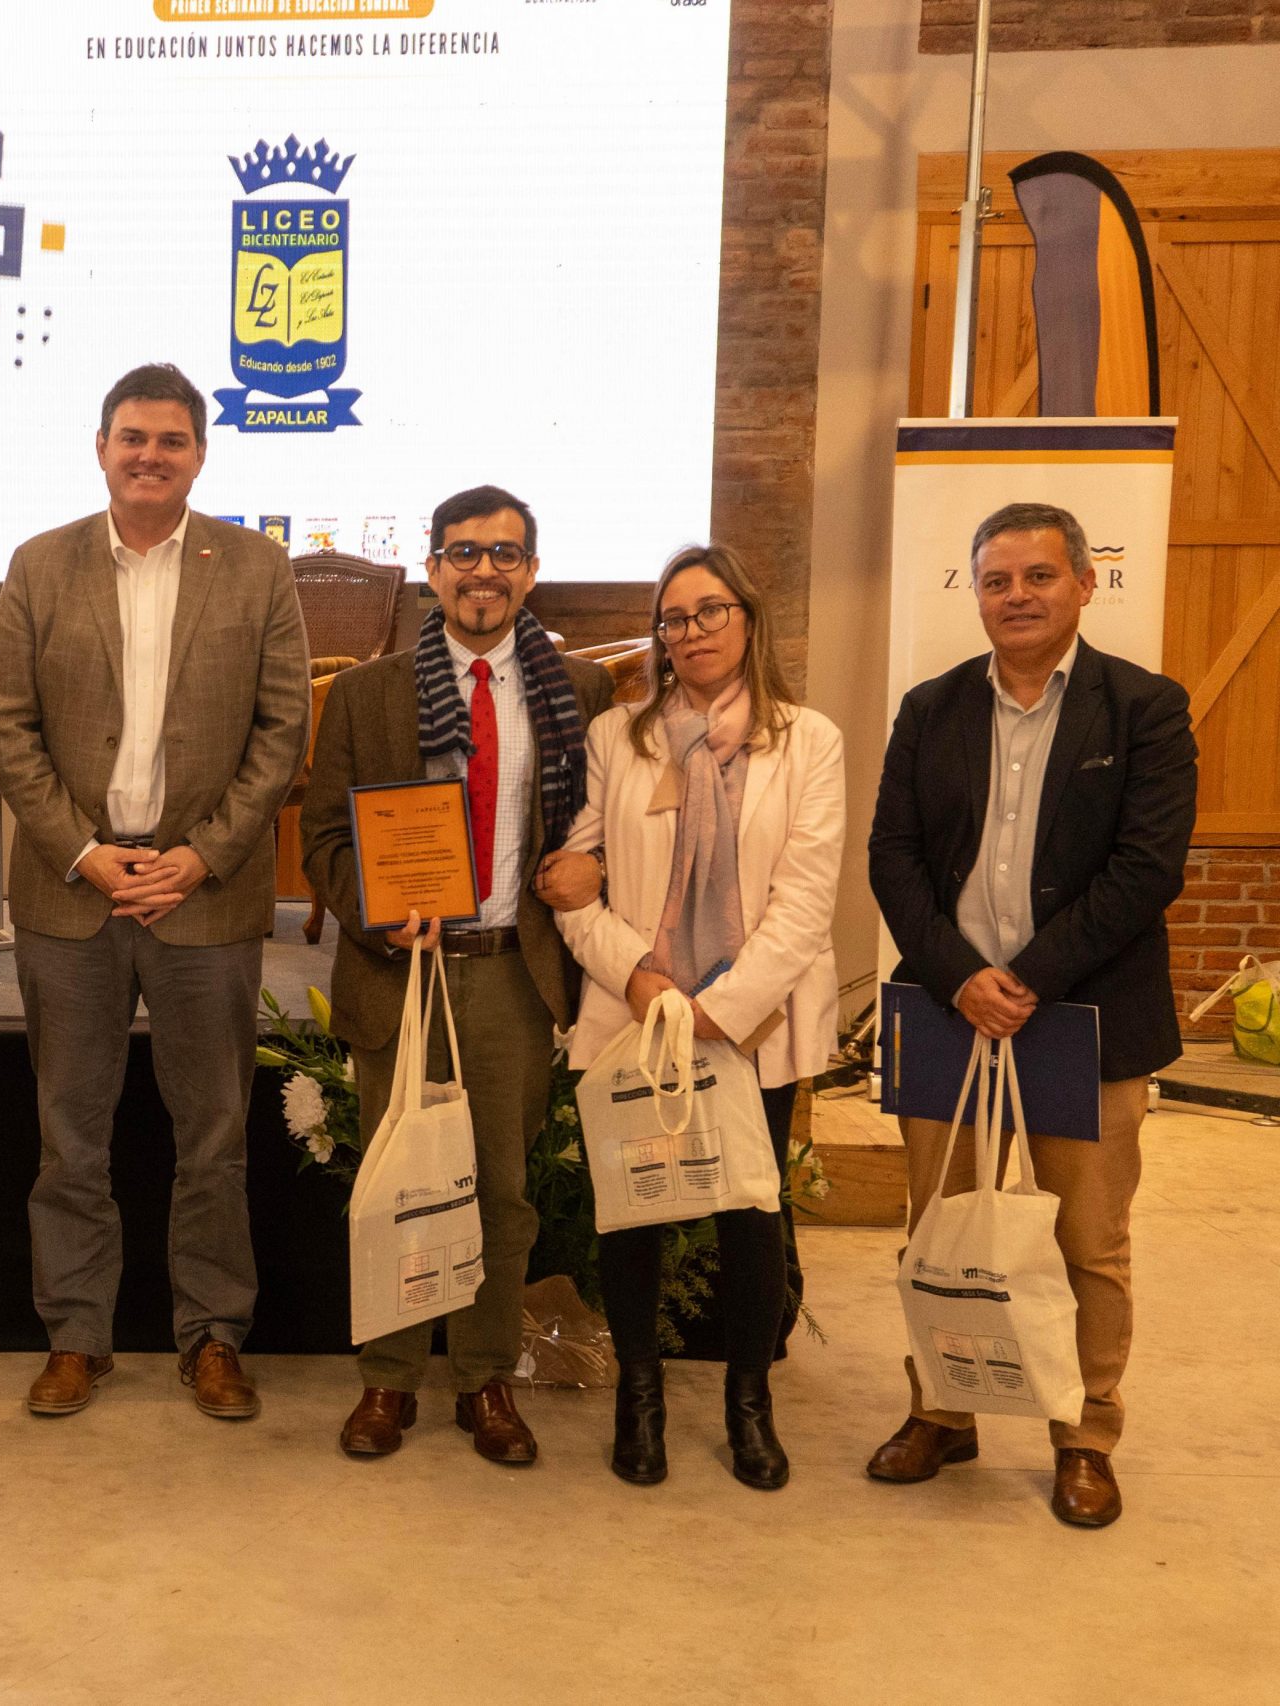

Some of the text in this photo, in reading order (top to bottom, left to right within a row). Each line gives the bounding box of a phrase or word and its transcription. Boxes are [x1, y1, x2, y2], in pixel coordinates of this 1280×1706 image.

[87, 31, 500, 59] EN EDUCACIÓN JUNTOS HACEMOS LA DIFERENCIA
[241, 209, 341, 231] LICEO
[242, 232, 340, 247] BICENTENARIO
[239, 353, 337, 374] Educando desde 1902
[245, 409, 329, 426] ZAPALLAR
